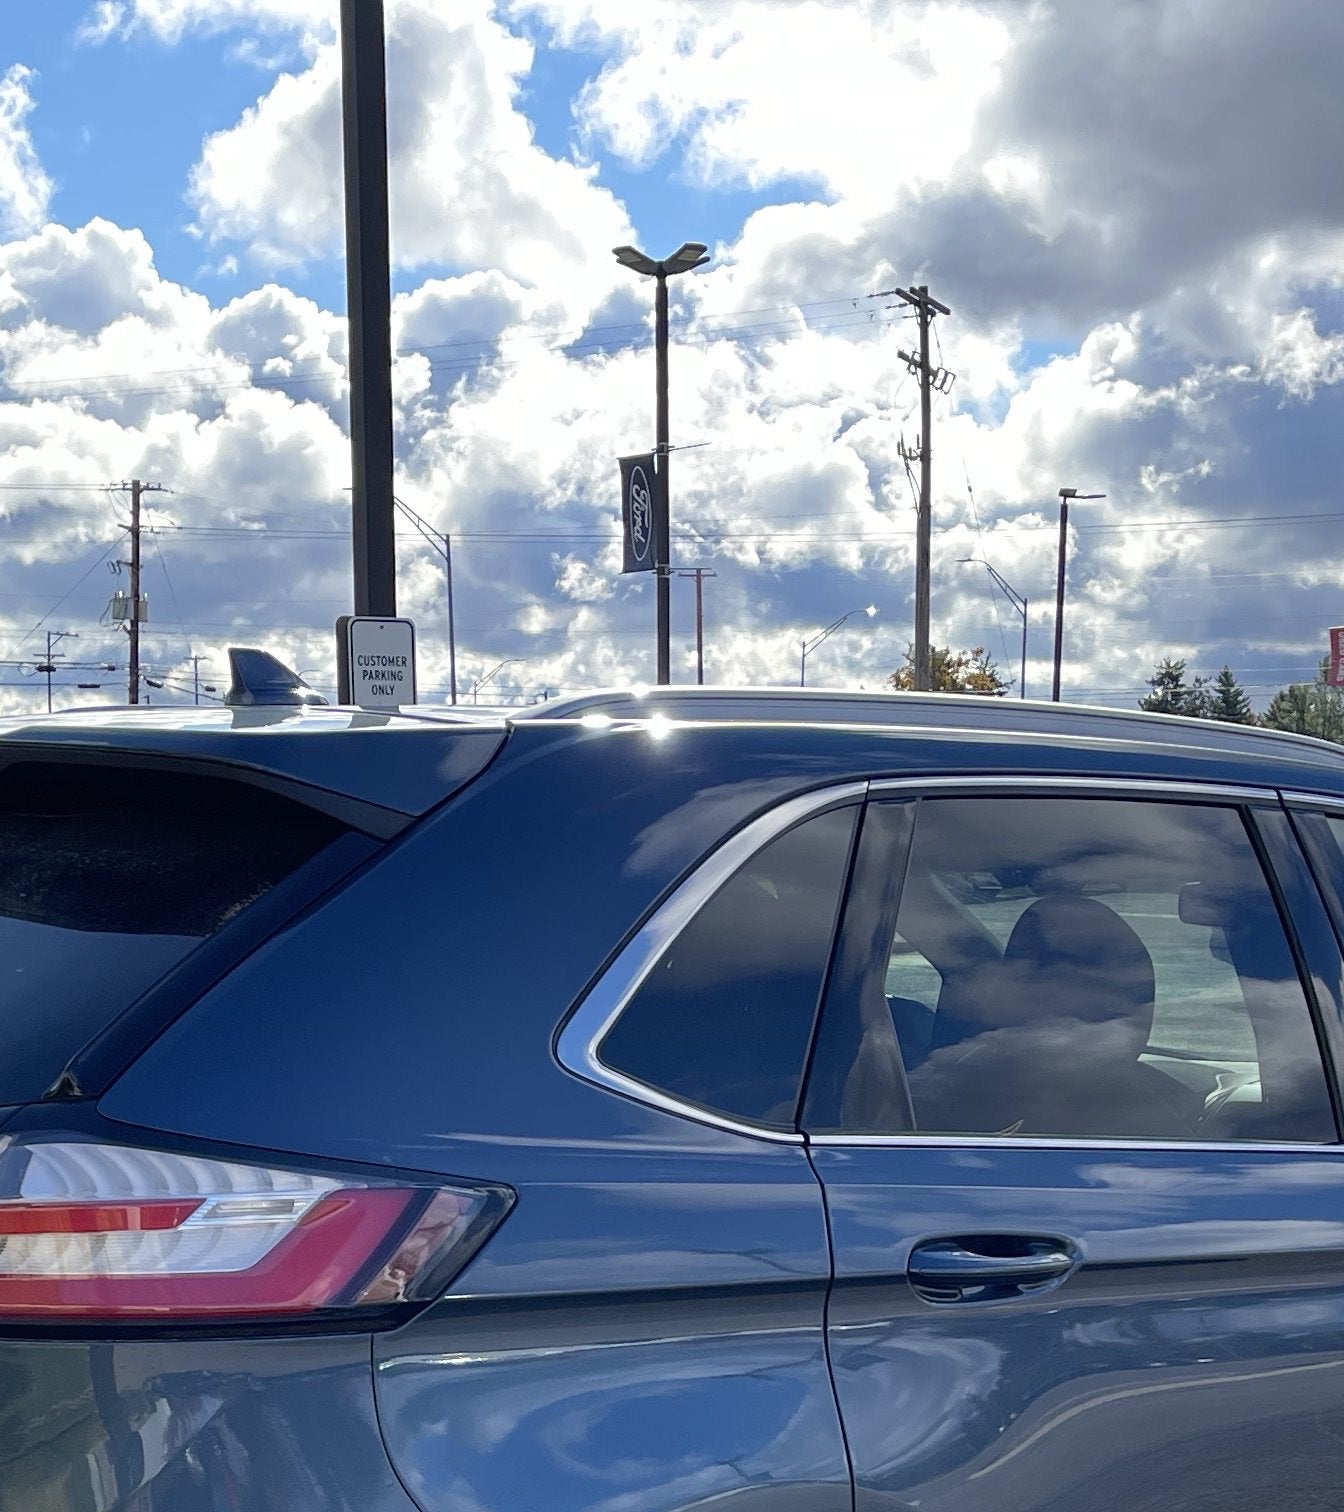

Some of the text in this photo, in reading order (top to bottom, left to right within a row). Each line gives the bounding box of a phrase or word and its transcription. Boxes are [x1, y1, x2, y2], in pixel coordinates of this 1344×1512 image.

[632, 484, 649, 543] Ford
[357, 655, 408, 668] CUSTOMER
[362, 670, 404, 682] PARKING
[371, 685, 396, 696] ONLY
